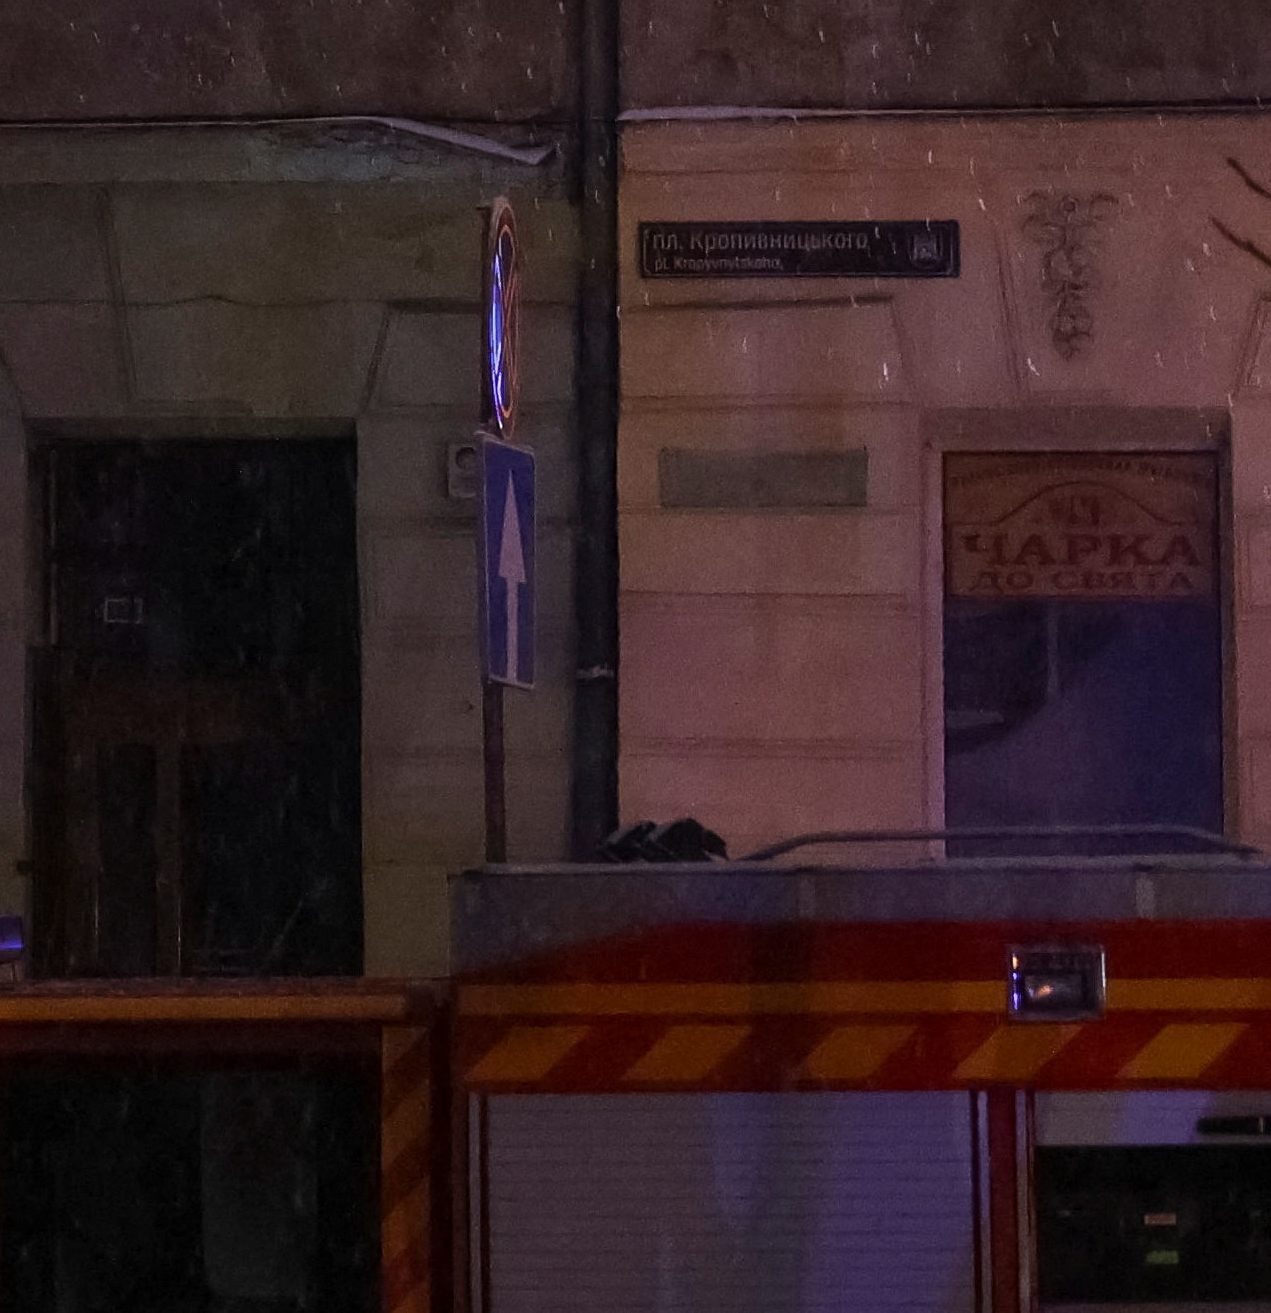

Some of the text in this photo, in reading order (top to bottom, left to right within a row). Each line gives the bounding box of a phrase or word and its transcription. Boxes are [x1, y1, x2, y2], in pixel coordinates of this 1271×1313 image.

[652, 232, 868, 256] пл. Кропивницького
[963, 534, 1201, 565] ЧАРКА
